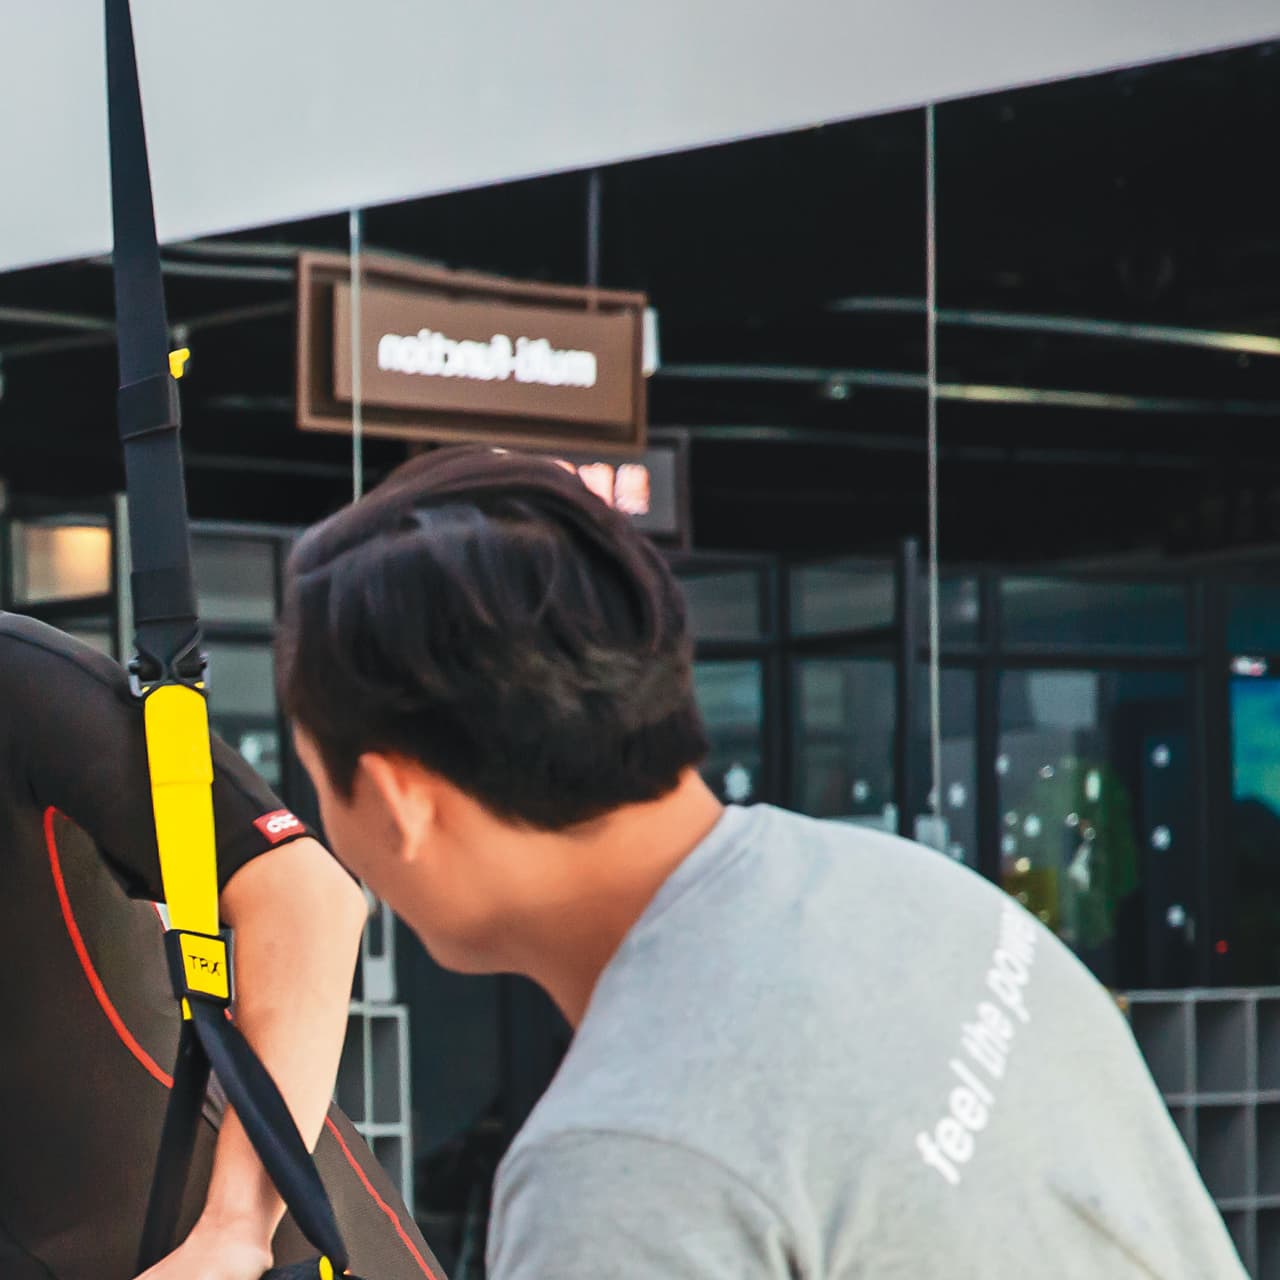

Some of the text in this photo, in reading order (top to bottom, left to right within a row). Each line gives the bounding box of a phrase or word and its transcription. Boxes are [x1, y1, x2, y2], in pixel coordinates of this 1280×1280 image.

[184, 953, 223, 977] TRX
[914, 1057, 996, 1186] feel
[960, 1000, 1016, 1081] the
